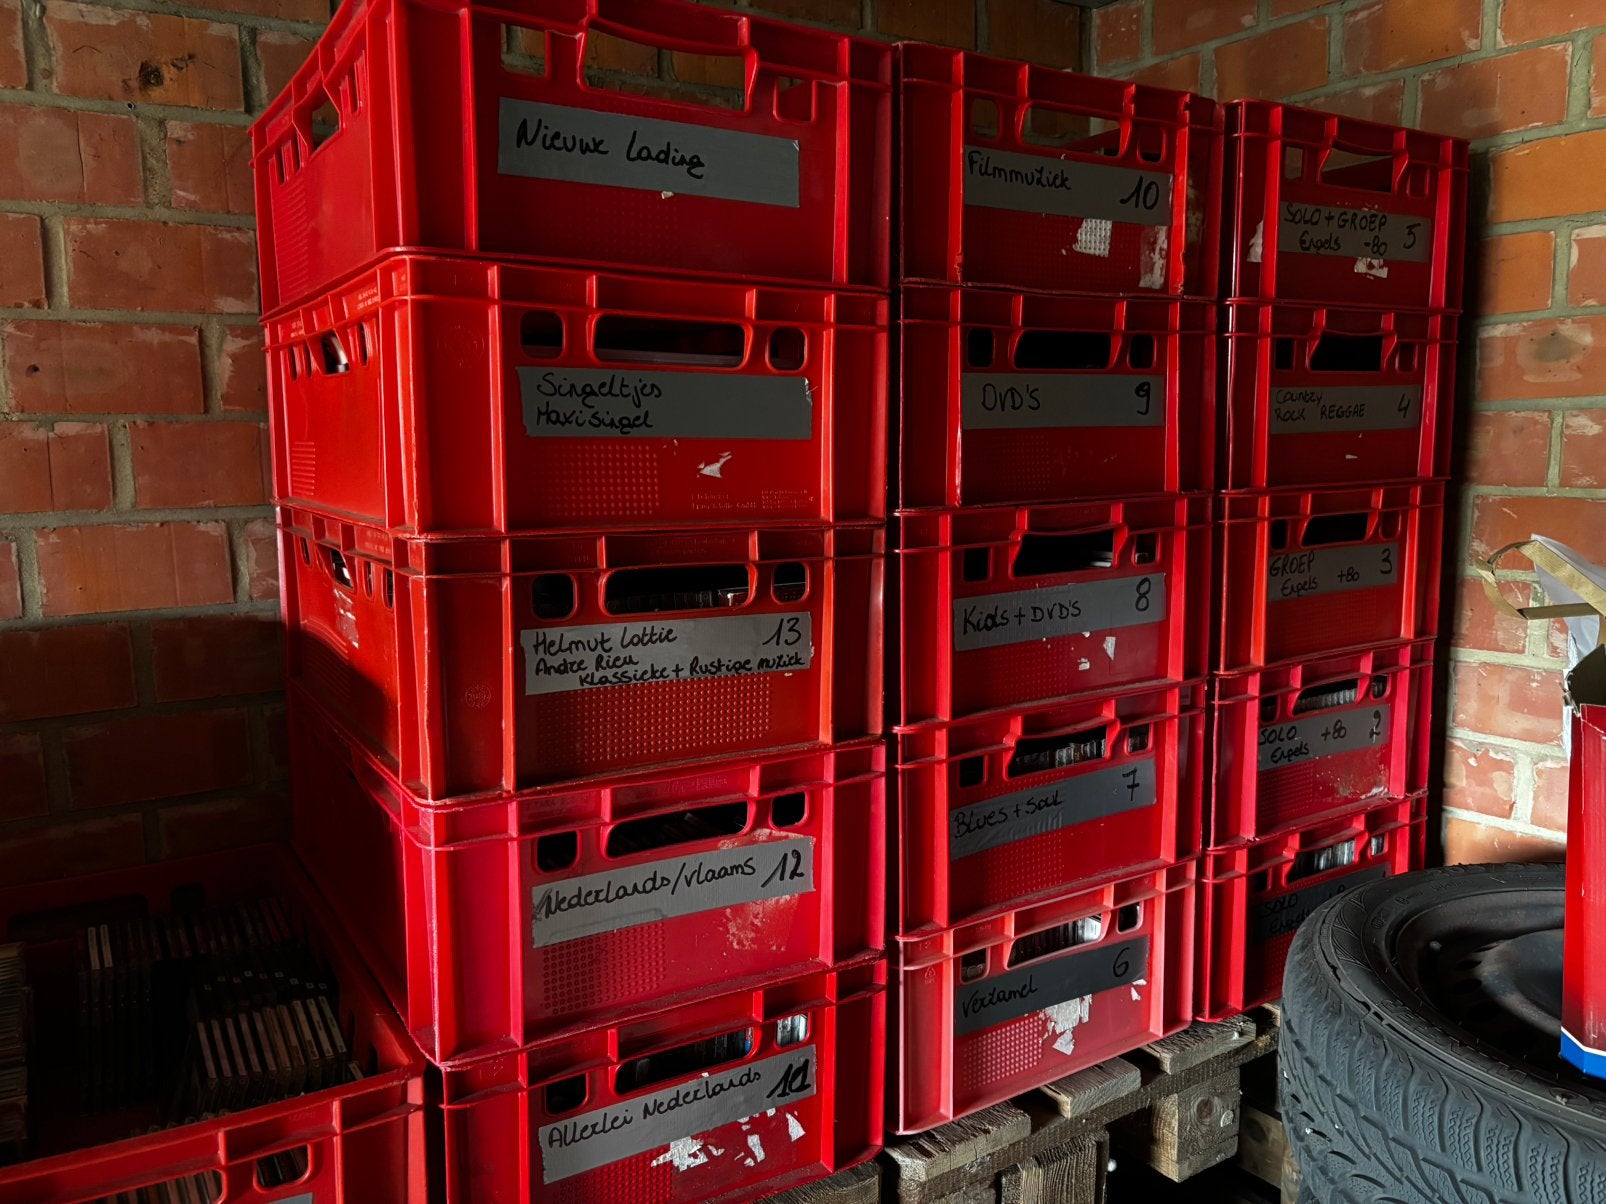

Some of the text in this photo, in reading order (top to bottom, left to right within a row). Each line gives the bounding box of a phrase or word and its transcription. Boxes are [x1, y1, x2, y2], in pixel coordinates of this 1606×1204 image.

[515, 117, 706, 179] Nieuwe Lading
[1120, 175, 1160, 210] 10
[1284, 202, 1322, 226] SOLO
[1337, 211, 1388, 233] GROEP
[1299, 230, 1342, 255] Engels
[1403, 222, 1421, 249] 5
[536, 372, 662, 408] Singeltjes
[1134, 381, 1151, 415] 9
[1320, 403, 1366, 420] REGGAE
[1397, 393, 1411, 419] 4
[1269, 551, 1315, 577] GROEP
[1380, 547, 1393, 575] 3
[1281, 575, 1319, 598] Engels
[963, 604, 1010, 636] Kids
[1134, 577, 1151, 612] 8
[533, 616, 802, 656] Helmut Lottie 13
[535, 653, 639, 676] Andre Rieu
[689, 656, 752, 676] Rustige
[1258, 725, 1297, 746] SOLO
[1270, 741, 1310, 764] Engels
[954, 808, 1009, 839] Blues
[1122, 767, 1141, 802] 7
[760, 848, 805, 888] 12
[1112, 947, 1131, 978] 6
[548, 1108, 634, 1149] Allerlei
[642, 1067, 762, 1120] Nederlands
